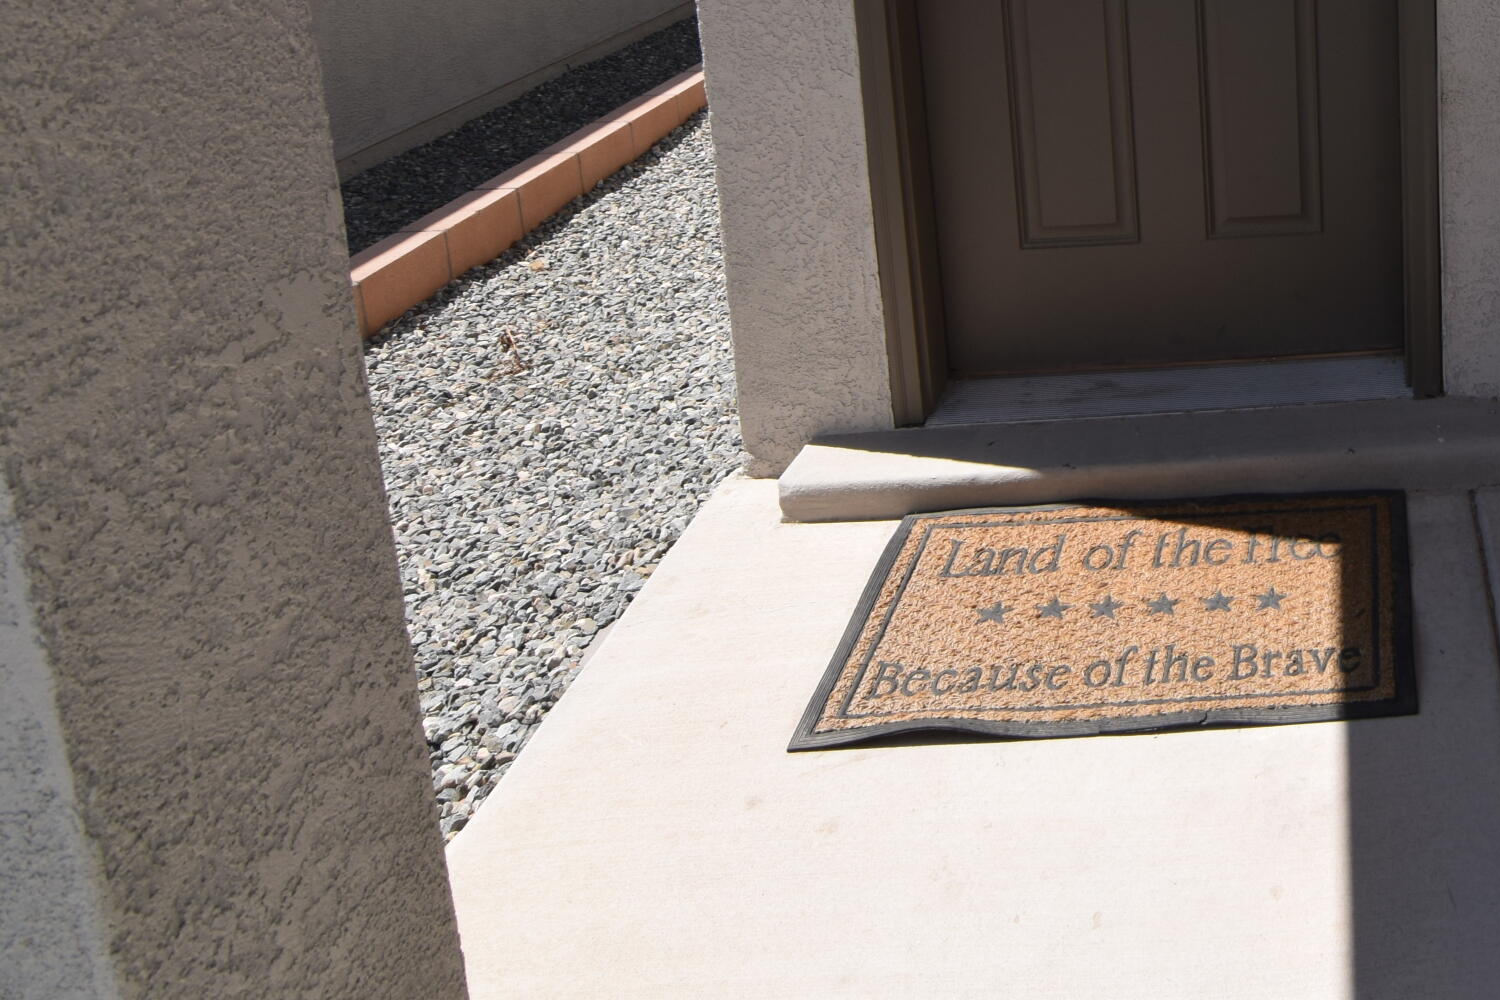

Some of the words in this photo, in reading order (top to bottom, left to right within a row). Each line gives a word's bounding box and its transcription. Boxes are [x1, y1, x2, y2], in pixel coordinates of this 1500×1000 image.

[938, 533, 1066, 578] Land
[1082, 529, 1142, 571] of
[1152, 527, 1232, 568] the
[1242, 526, 1344, 564] Free
[866, 661, 1073, 700] Because
[1083, 645, 1138, 688] of
[1142, 644, 1215, 686] the
[1226, 643, 1362, 682] Brave
